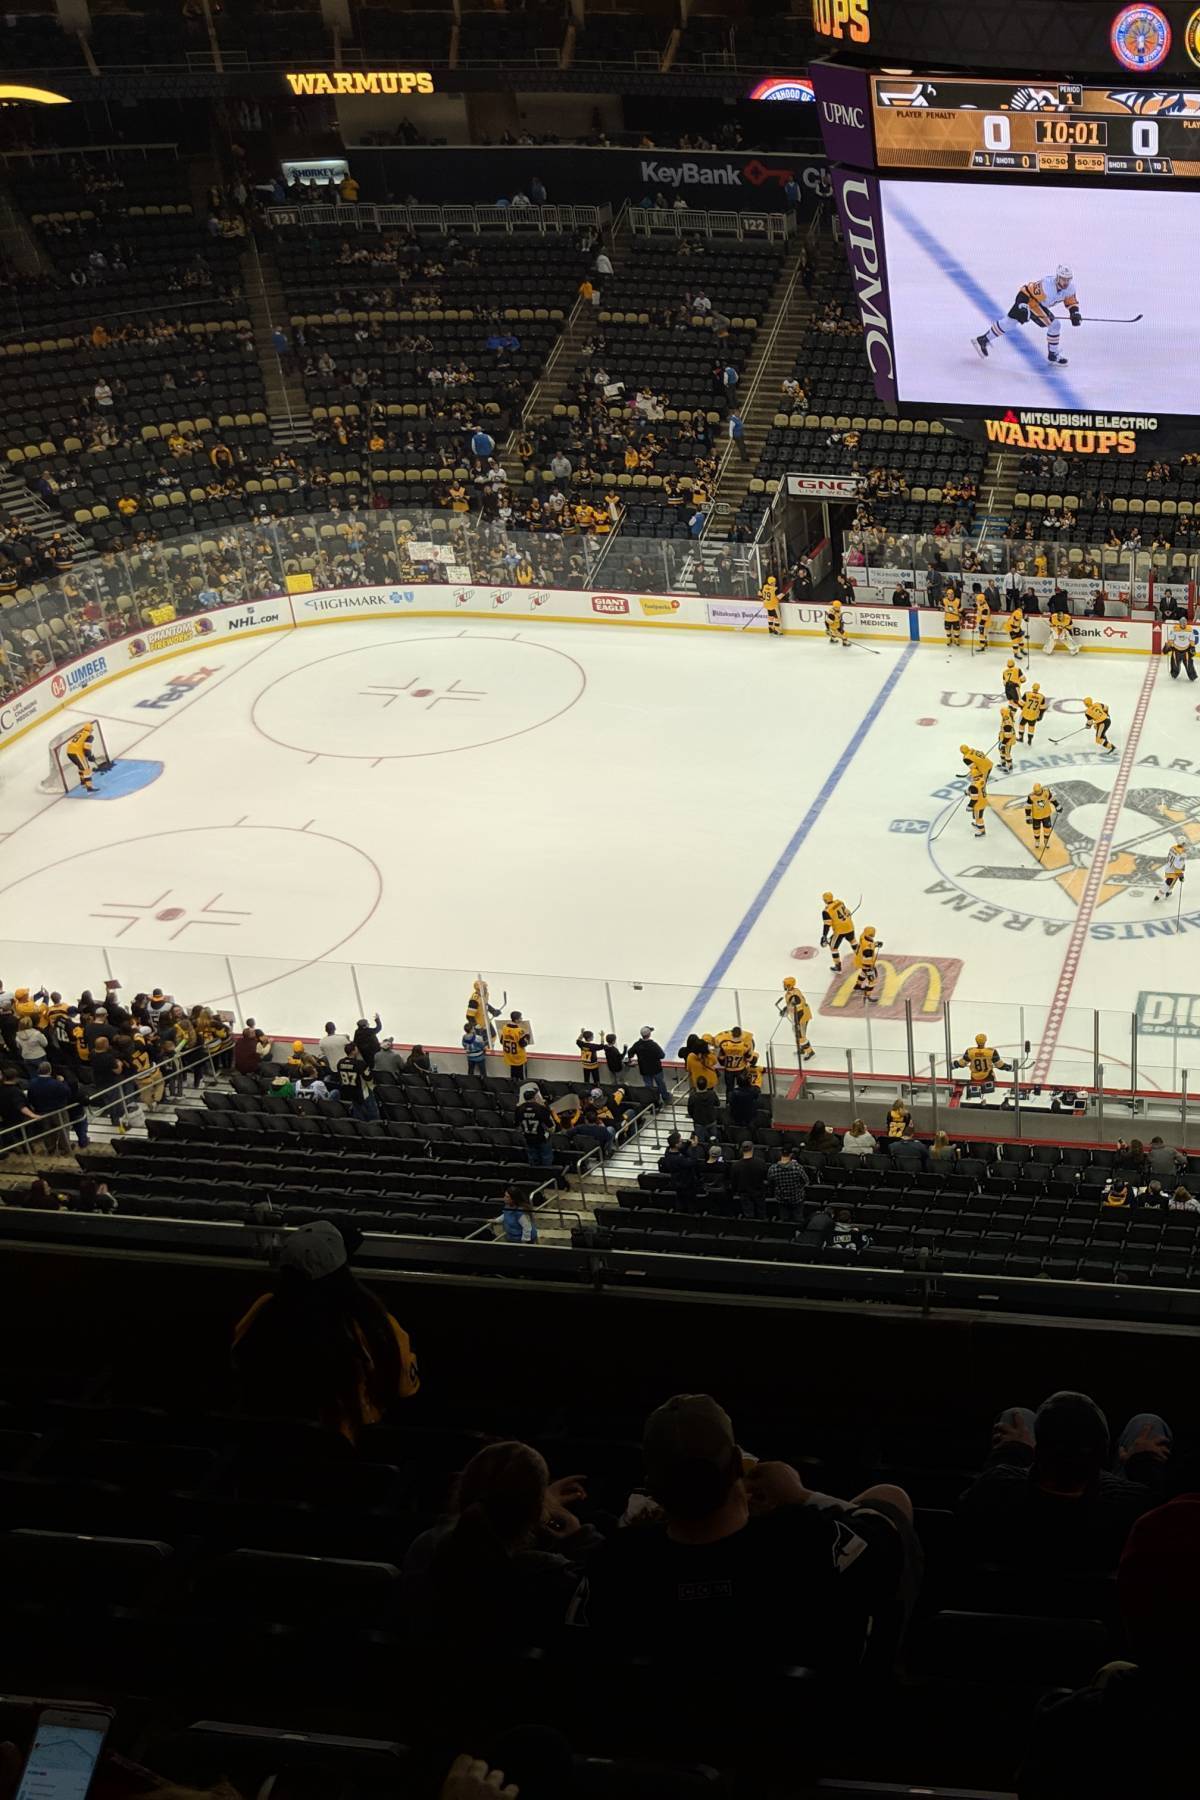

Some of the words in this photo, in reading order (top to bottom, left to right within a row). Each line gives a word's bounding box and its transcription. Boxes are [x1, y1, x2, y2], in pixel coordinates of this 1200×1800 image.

[286, 72, 435, 95] WARMUPS
[1059, 85, 1081, 94] PERIOD
[1066, 94, 1075, 105] 1
[824, 101, 865, 130] UPMC
[896, 110, 922, 120] PLAYER
[926, 111, 957, 121] PENALTY
[984, 115, 1011, 151] 0
[1043, 121, 1100, 145] 10:01
[1132, 120, 1159, 156] 0
[1040, 156, 1067, 165] 50/50
[1076, 158, 1103, 168] 50/50
[292, 168, 335, 178] SHORKEY
[640, 161, 742, 188] KeyBank
[273, 213, 297, 225] 121
[743, 219, 765, 231] 122
[842, 178, 894, 381] UPMC
[1020, 411, 1092, 427] MITSUBISHI
[1095, 415, 1158, 430] ELECTRIC
[986, 419, 1136, 455] WARMUPS
[312, 593, 387, 611] HIGHMARK
[594, 597, 625, 607] GIANT
[596, 603, 626, 613] EAGLE
[798, 608, 854, 625] UPC
[859, 612, 891, 620] SPORTS
[860, 619, 899, 628] MEDICINE
[148, 621, 193, 643] PHANTOM
[149, 632, 195, 652] FIREWORKS
[66, 657, 108, 686] LUMBER
[52, 681, 65, 696] 84
[940, 690, 1087, 714] UPC
[1018, 752, 1121, 773] AINTS
[890, 820, 930, 834] PPG
[923, 879, 1072, 937] ARENA
[503, 1040, 517, 1055] 58
[725, 1055, 742, 1069] 87
[973, 1058, 989, 1073] 81
[522, 1119, 541, 1135] 17
